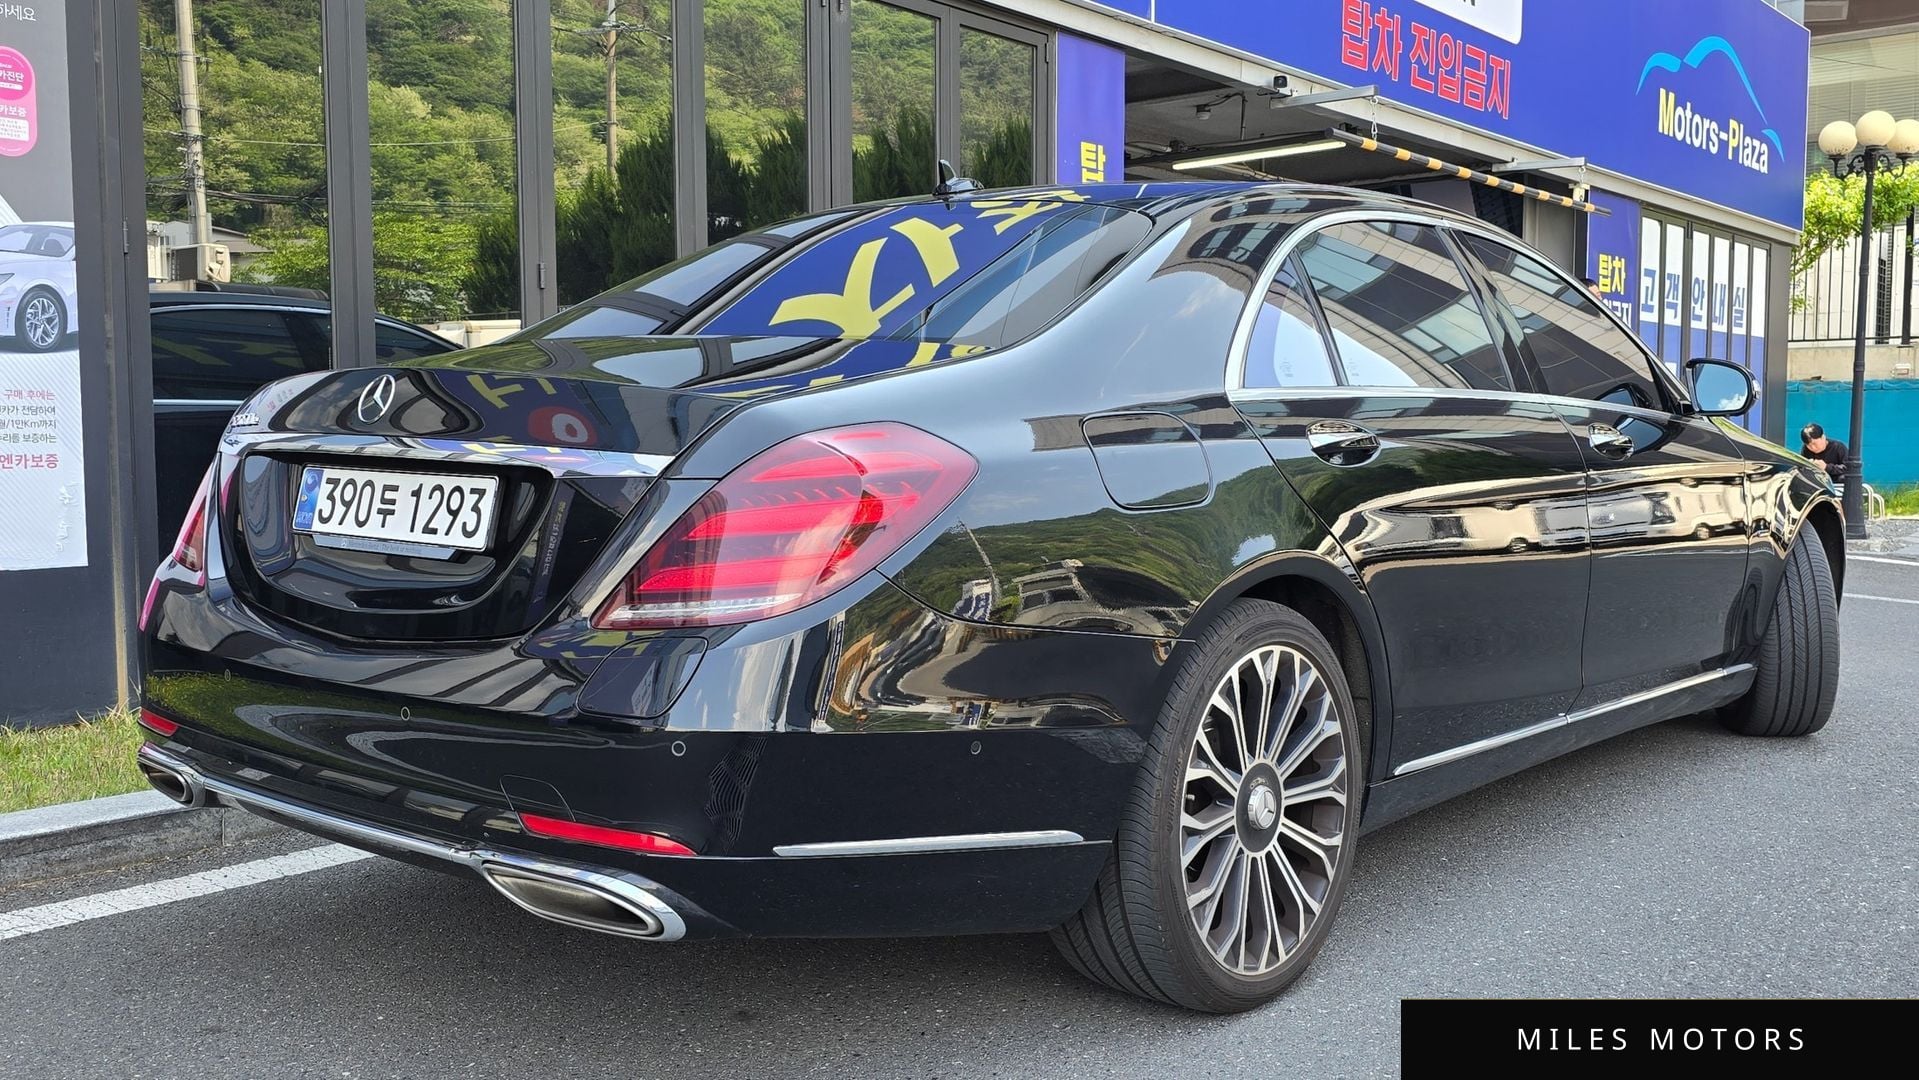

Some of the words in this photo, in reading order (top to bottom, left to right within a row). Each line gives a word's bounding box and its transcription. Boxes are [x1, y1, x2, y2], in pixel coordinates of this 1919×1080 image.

[1341, 0, 1402, 82] 탑차
[1410, 21, 1511, 120] 진입금지
[1658, 87, 1768, 174] Motors-Plaza
[1599, 253, 1626, 295] 탑차
[0, 405, 20, 415] 카가
[21, 405, 56, 416] 전담하여
[4, 389, 23, 400] 구매
[27, 389, 56, 401] 후에는
[22, 433, 57, 444] 보증하는
[318, 477, 400, 528] 390두
[409, 483, 487, 539] 1293
